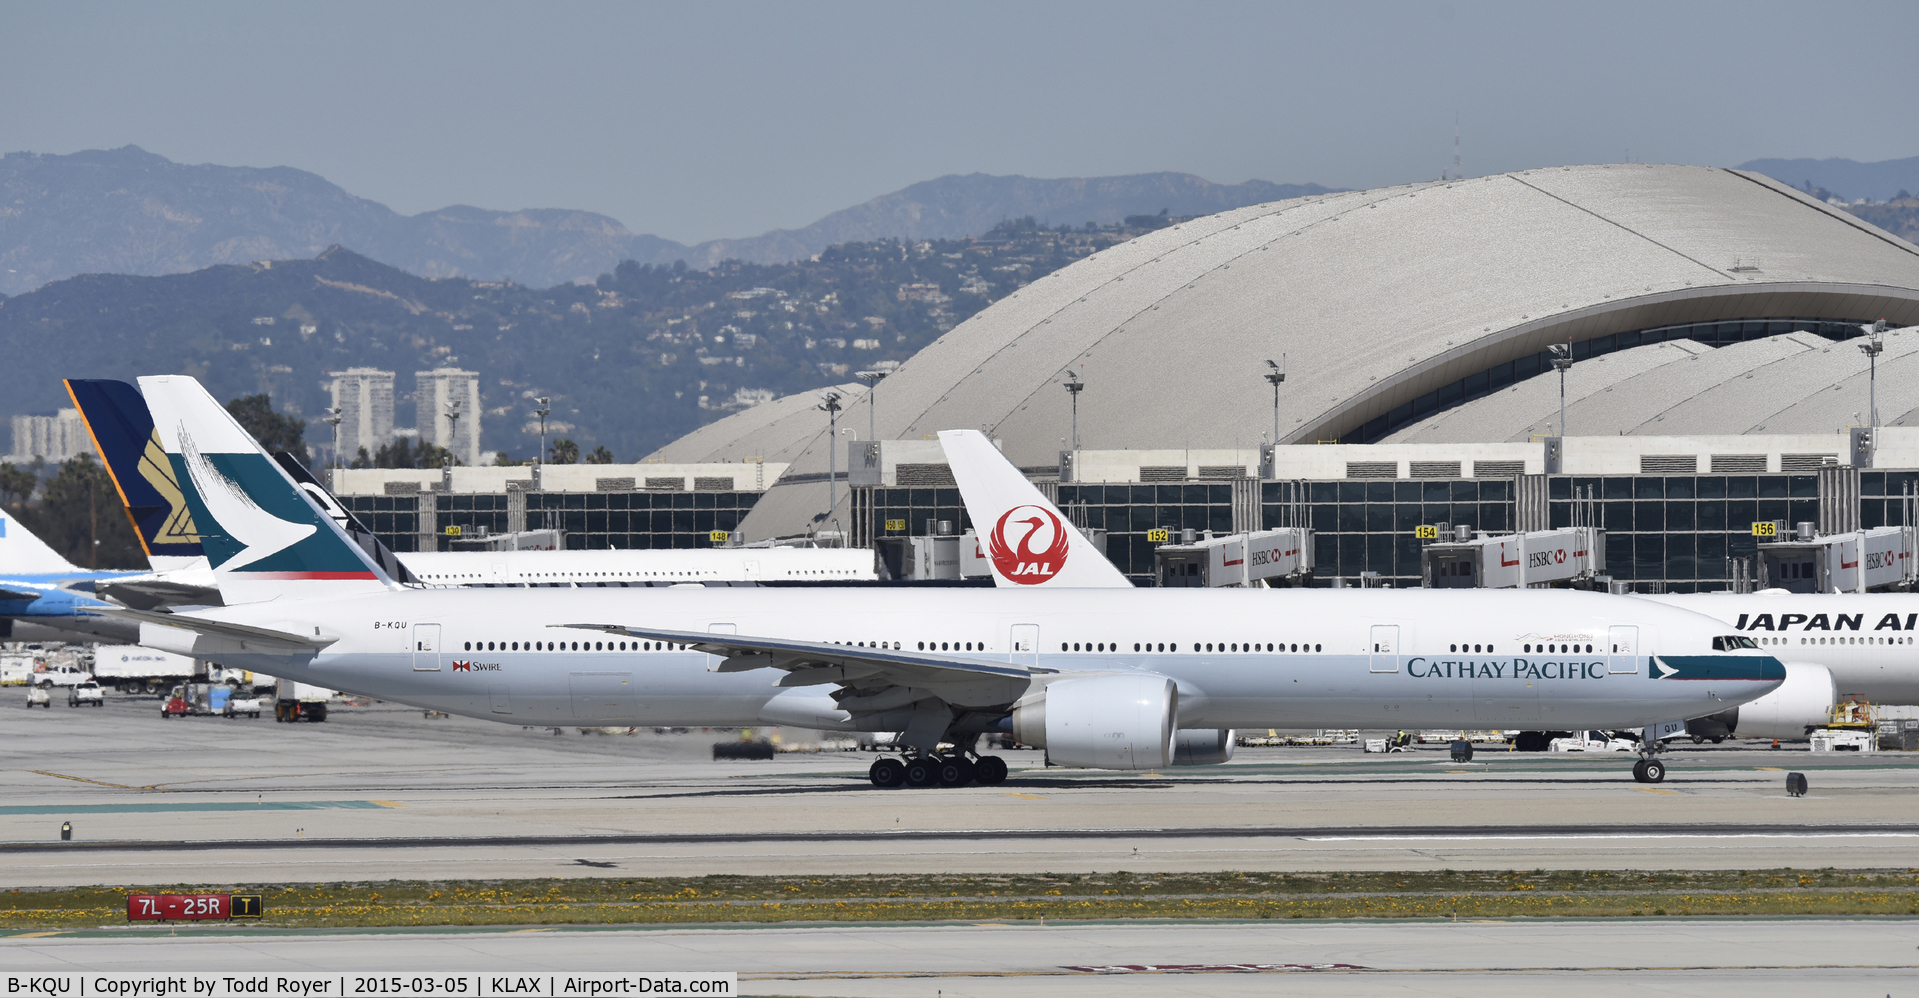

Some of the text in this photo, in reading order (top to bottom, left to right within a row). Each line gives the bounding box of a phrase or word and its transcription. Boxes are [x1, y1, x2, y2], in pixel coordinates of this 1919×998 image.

[447, 527, 459, 535] 130
[1418, 527, 1435, 538] 154
[1754, 523, 1774, 535] 156
[712, 532, 726, 540] 148
[1150, 530, 1166, 541] 152
[1252, 549, 1271, 566] HSBC
[1529, 550, 1553, 568] HSBC
[1866, 551, 1885, 570] HSBC
[1010, 562, 1054, 575] JAL
[374, 621, 407, 629] B-KQU
[1734, 613, 1919, 631] JAPAN AI
[1664, 724, 1678, 733] QU
[138, 899, 162, 915] 7L
[183, 898, 220, 915] 25R
[241, 898, 251, 914] T
